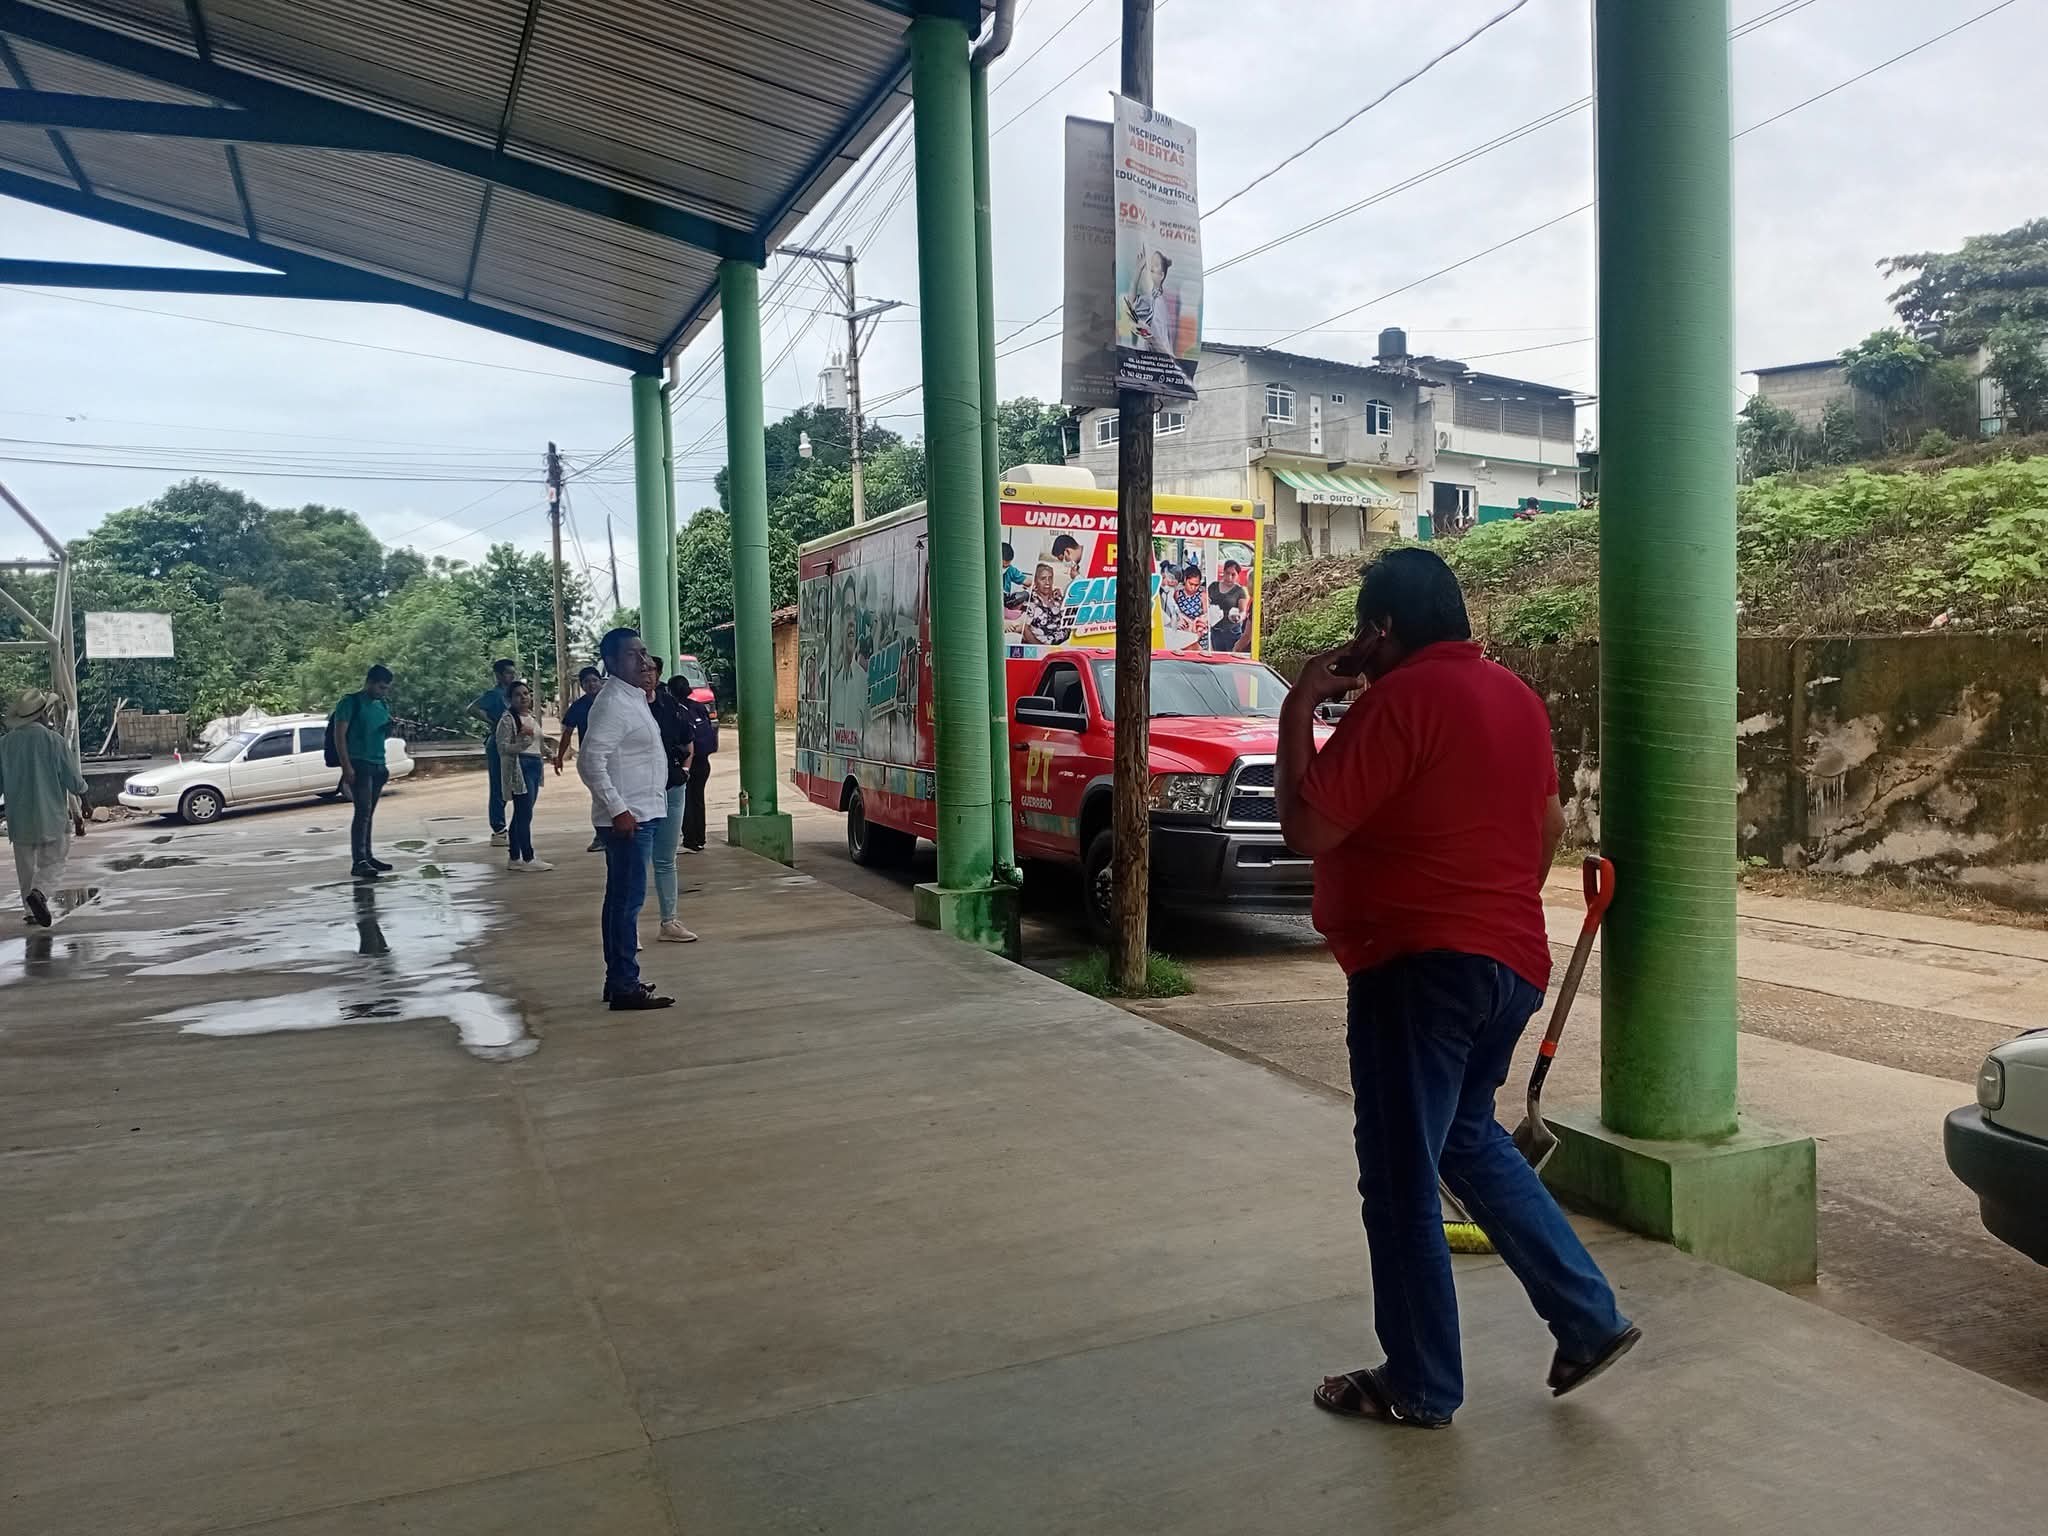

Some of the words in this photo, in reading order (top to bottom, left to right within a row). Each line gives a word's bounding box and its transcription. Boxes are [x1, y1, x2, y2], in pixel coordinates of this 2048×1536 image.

[1128, 124, 1185, 154] INSCRIPCIONES
[1129, 136, 1185, 167] ABIERTAS
[1119, 201, 1148, 223] 50%
[1159, 228, 1197, 244] GRATIS
[1024, 510, 1097, 529] UNIDAD
[1170, 518, 1225, 537] MÓVIL
[1061, 617, 1075, 627] TU
[1064, 607, 1079, 617] EN
[1026, 747, 1055, 793] PT
[1020, 794, 1053, 811] GUERRERO
